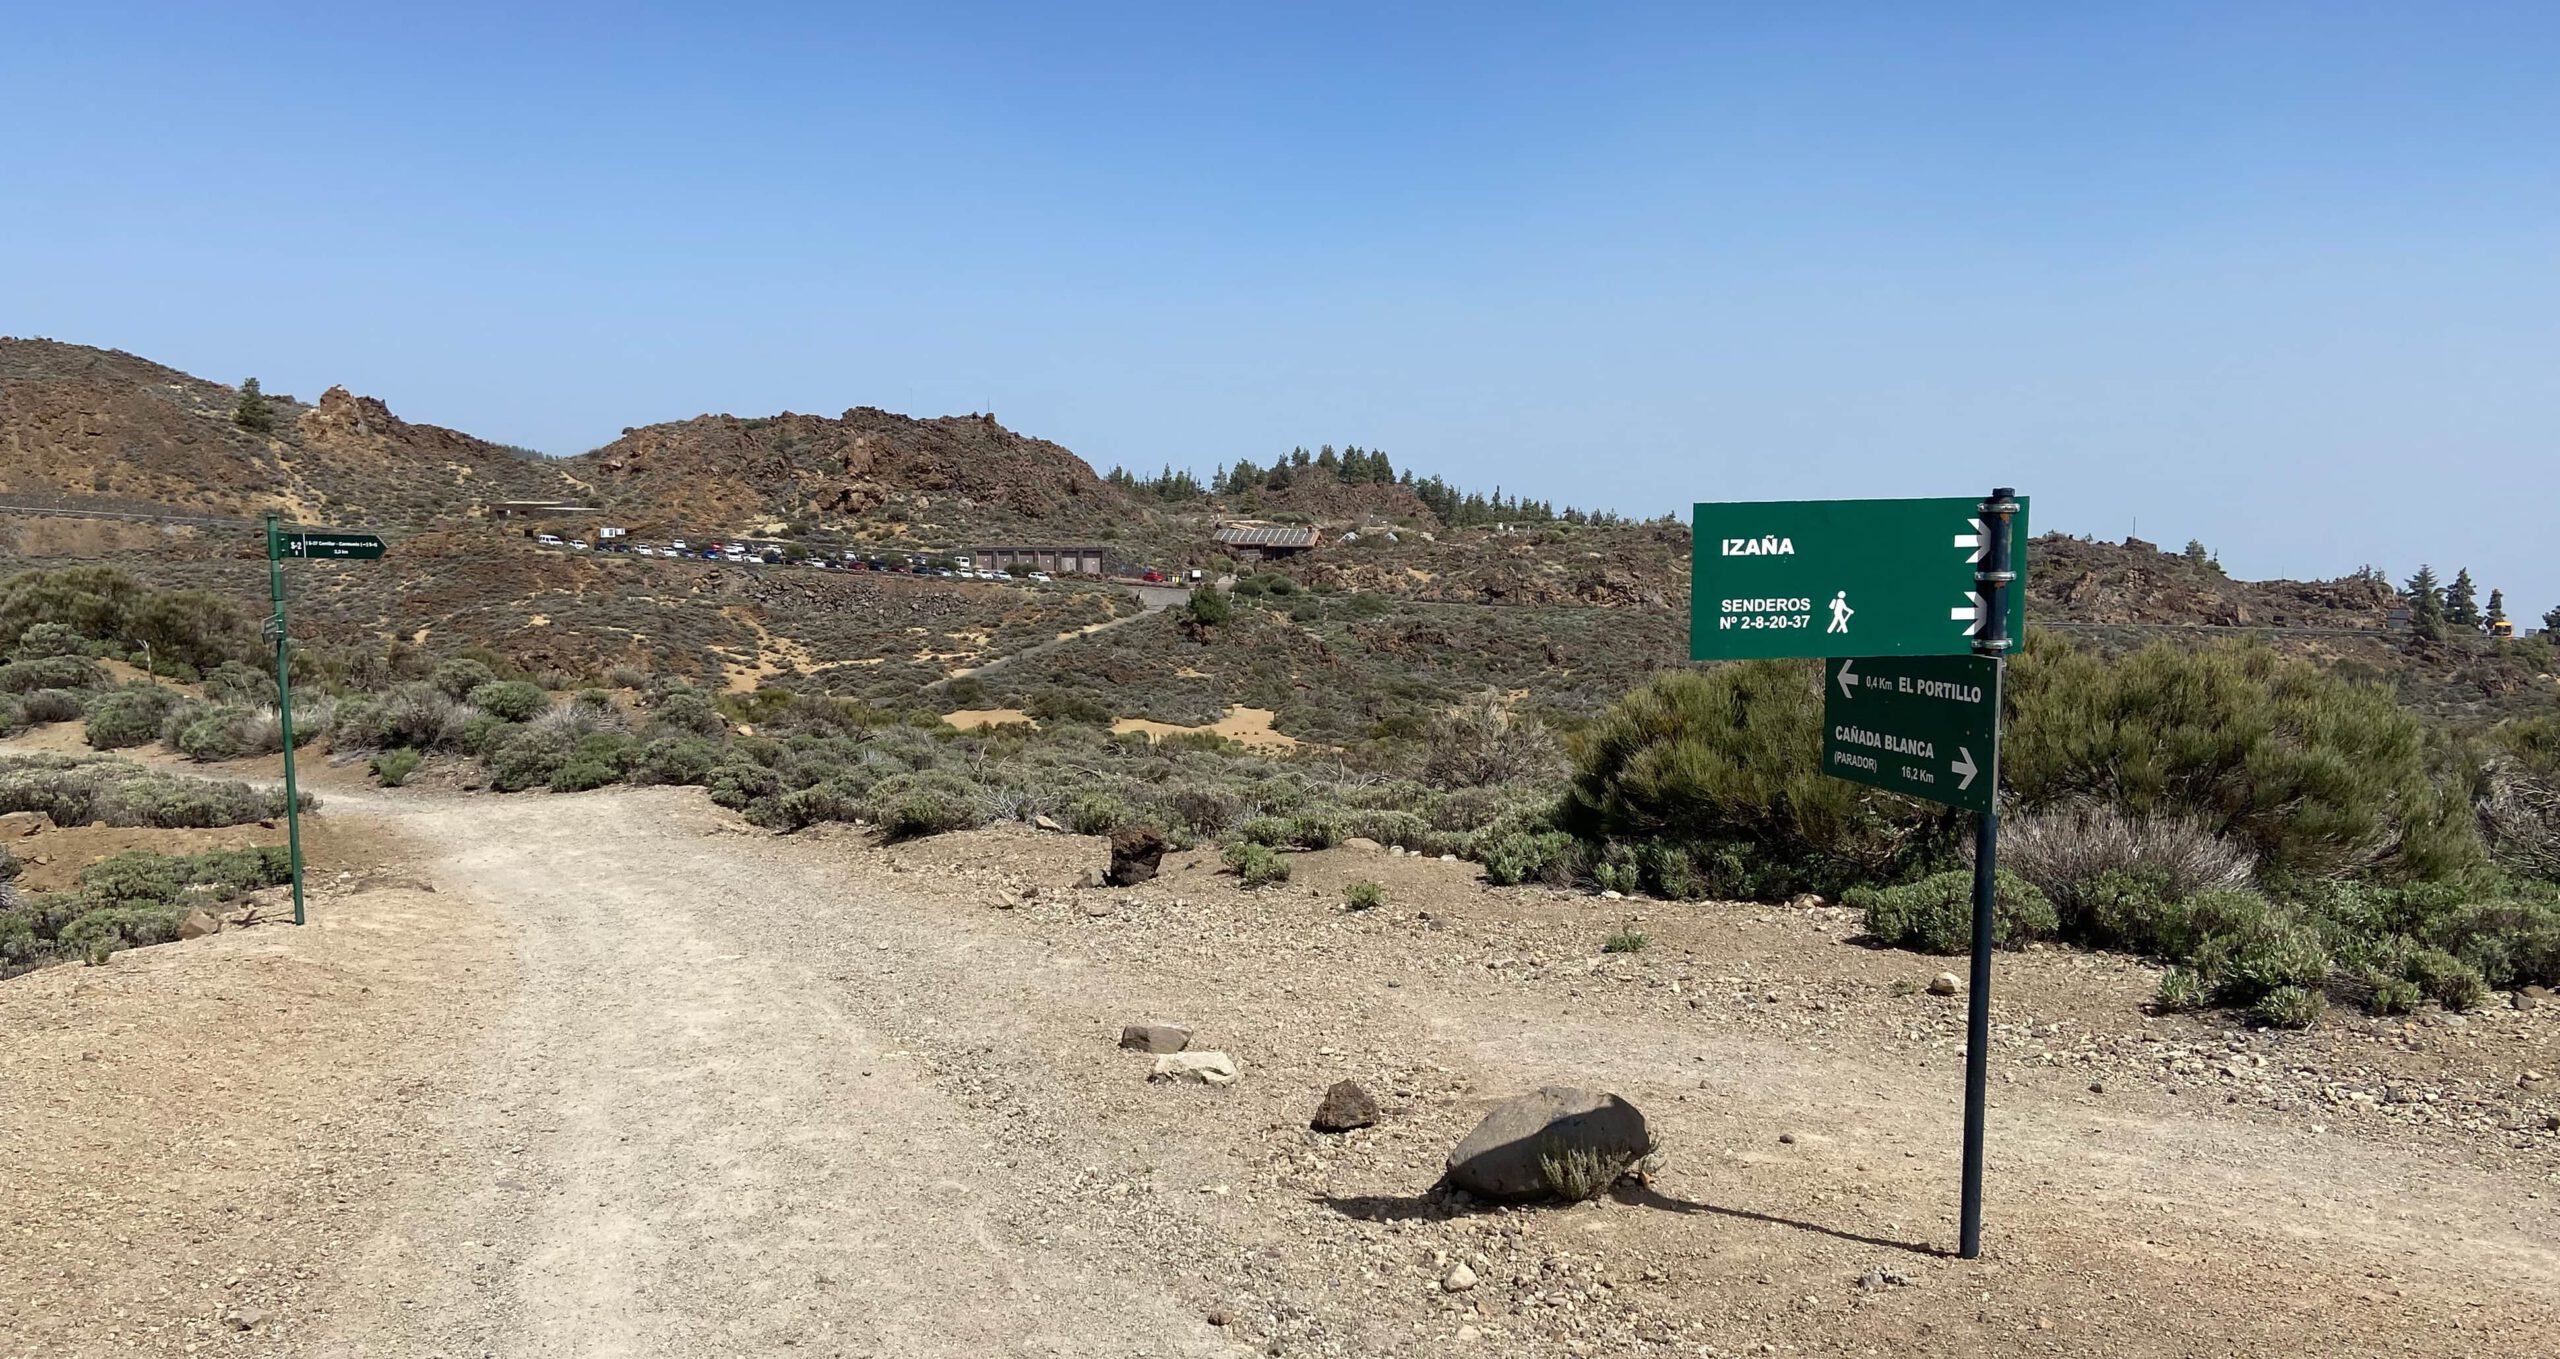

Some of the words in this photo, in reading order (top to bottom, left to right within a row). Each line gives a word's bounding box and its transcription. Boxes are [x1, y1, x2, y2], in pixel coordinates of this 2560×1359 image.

[290, 541, 302, 550] S-2
[1722, 535, 1795, 556] IZAÑA
[1721, 598, 1811, 613] SENDEROS
[1720, 616, 1737, 630] Nº
[1741, 615, 1811, 630] 2-8-20-37
[1866, 675, 1877, 689] 0,4
[1879, 677, 1893, 690] Km
[1899, 676, 1914, 693] EL
[1917, 679, 1982, 703] PORTILLO
[1835, 725, 1882, 748] CAÑADA
[1884, 734, 1935, 759] BLANCA
[1834, 751, 1878, 774] (PARADOR)
[1901, 765, 1918, 781] 16,2
[1919, 769, 1934, 784] Km
